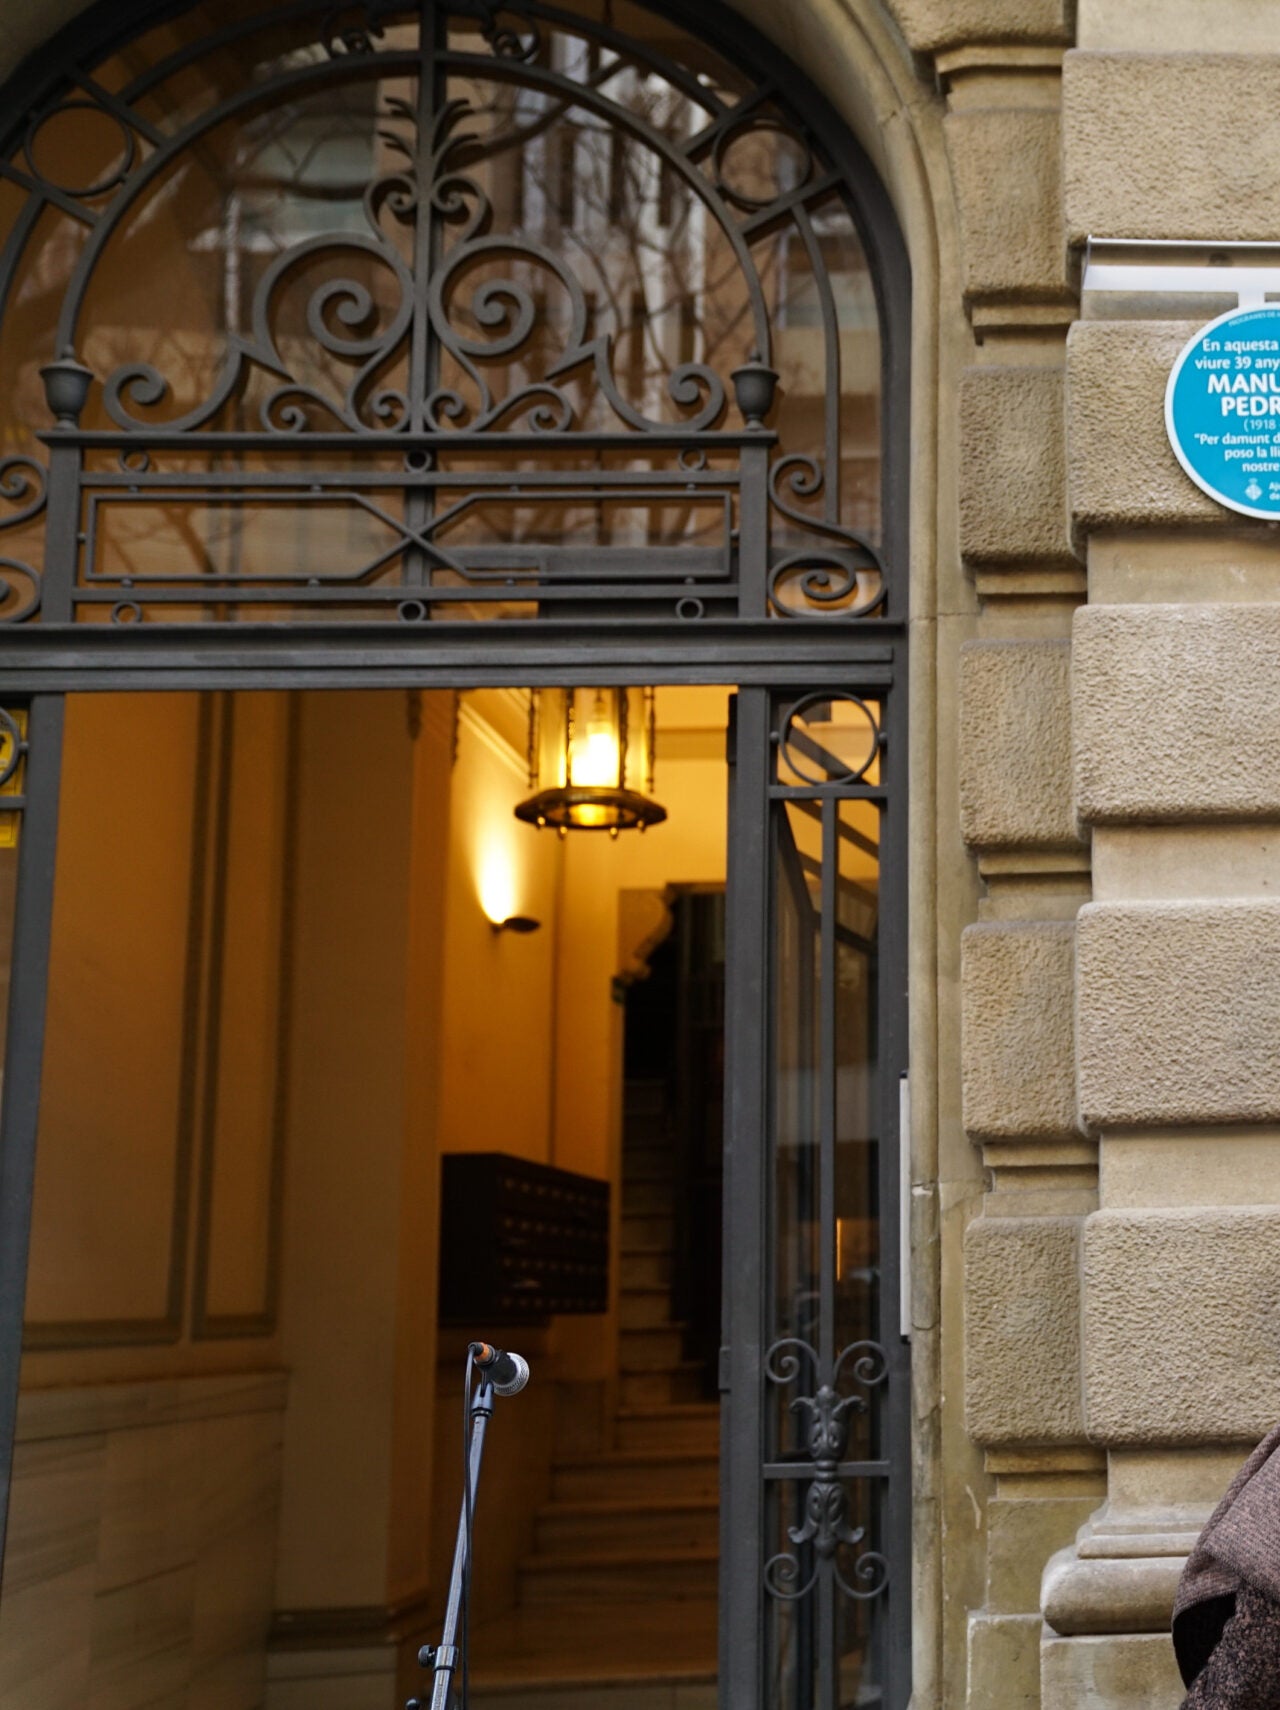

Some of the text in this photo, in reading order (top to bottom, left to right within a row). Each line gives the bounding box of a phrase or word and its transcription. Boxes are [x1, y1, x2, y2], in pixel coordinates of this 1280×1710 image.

[1202, 339, 1220, 352] En
[1224, 339, 1279, 354] aquesta
[1195, 356, 1230, 369] viure
[1235, 356, 1251, 369] 39
[1222, 433, 1270, 445] damunt
[1224, 448, 1254, 461] poso
[1257, 447, 1267, 458] la
[1242, 461, 1280, 472] nostre
[1269, 493, 1279, 501] de
